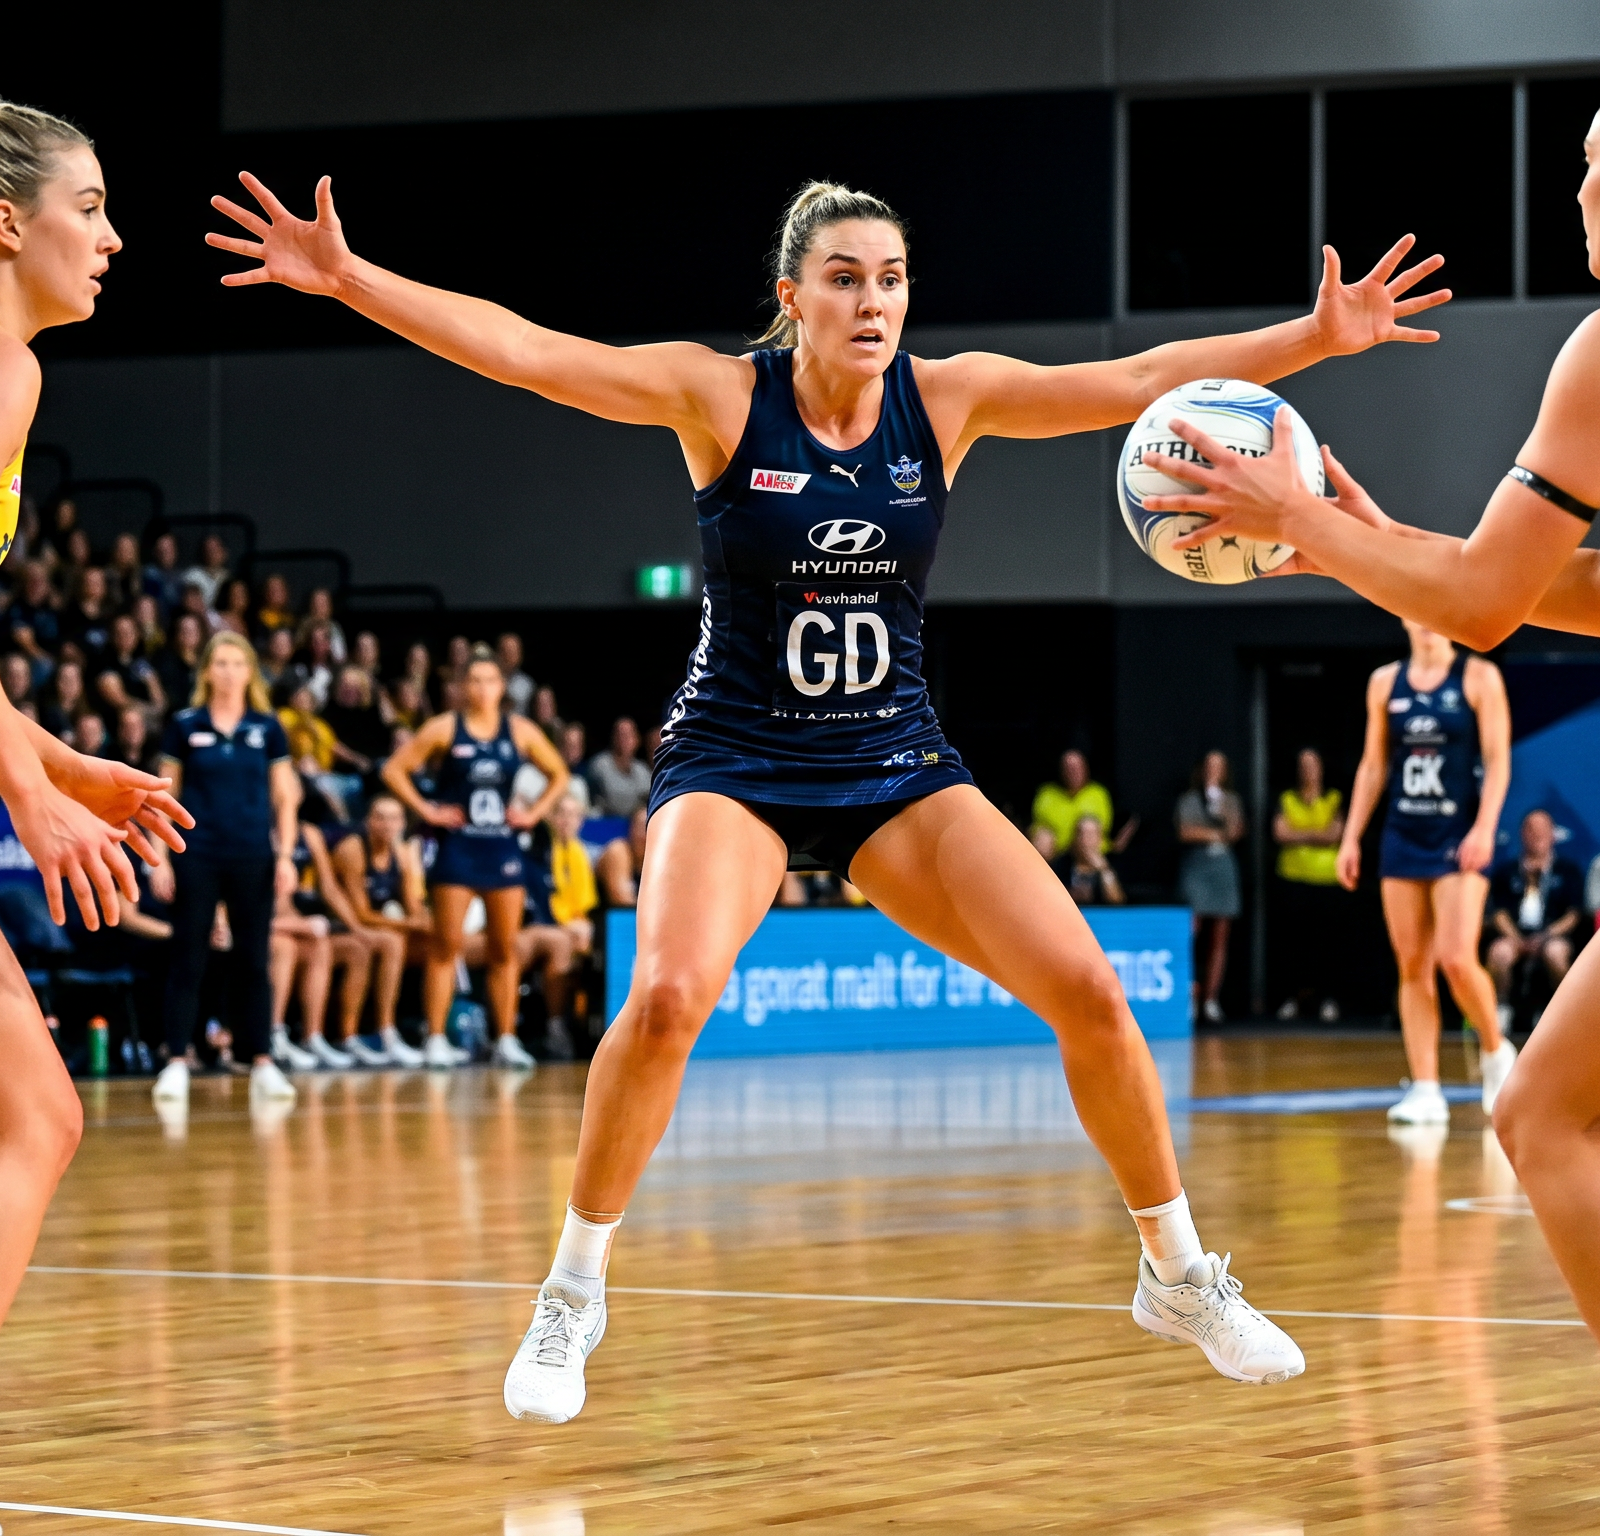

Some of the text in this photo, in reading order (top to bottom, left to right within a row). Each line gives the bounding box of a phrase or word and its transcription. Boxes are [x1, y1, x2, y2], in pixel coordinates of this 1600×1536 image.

[791, 560, 898, 574] HYUNDAI
[786, 610, 891, 697] GD
[1402, 754, 1445, 796] GK
